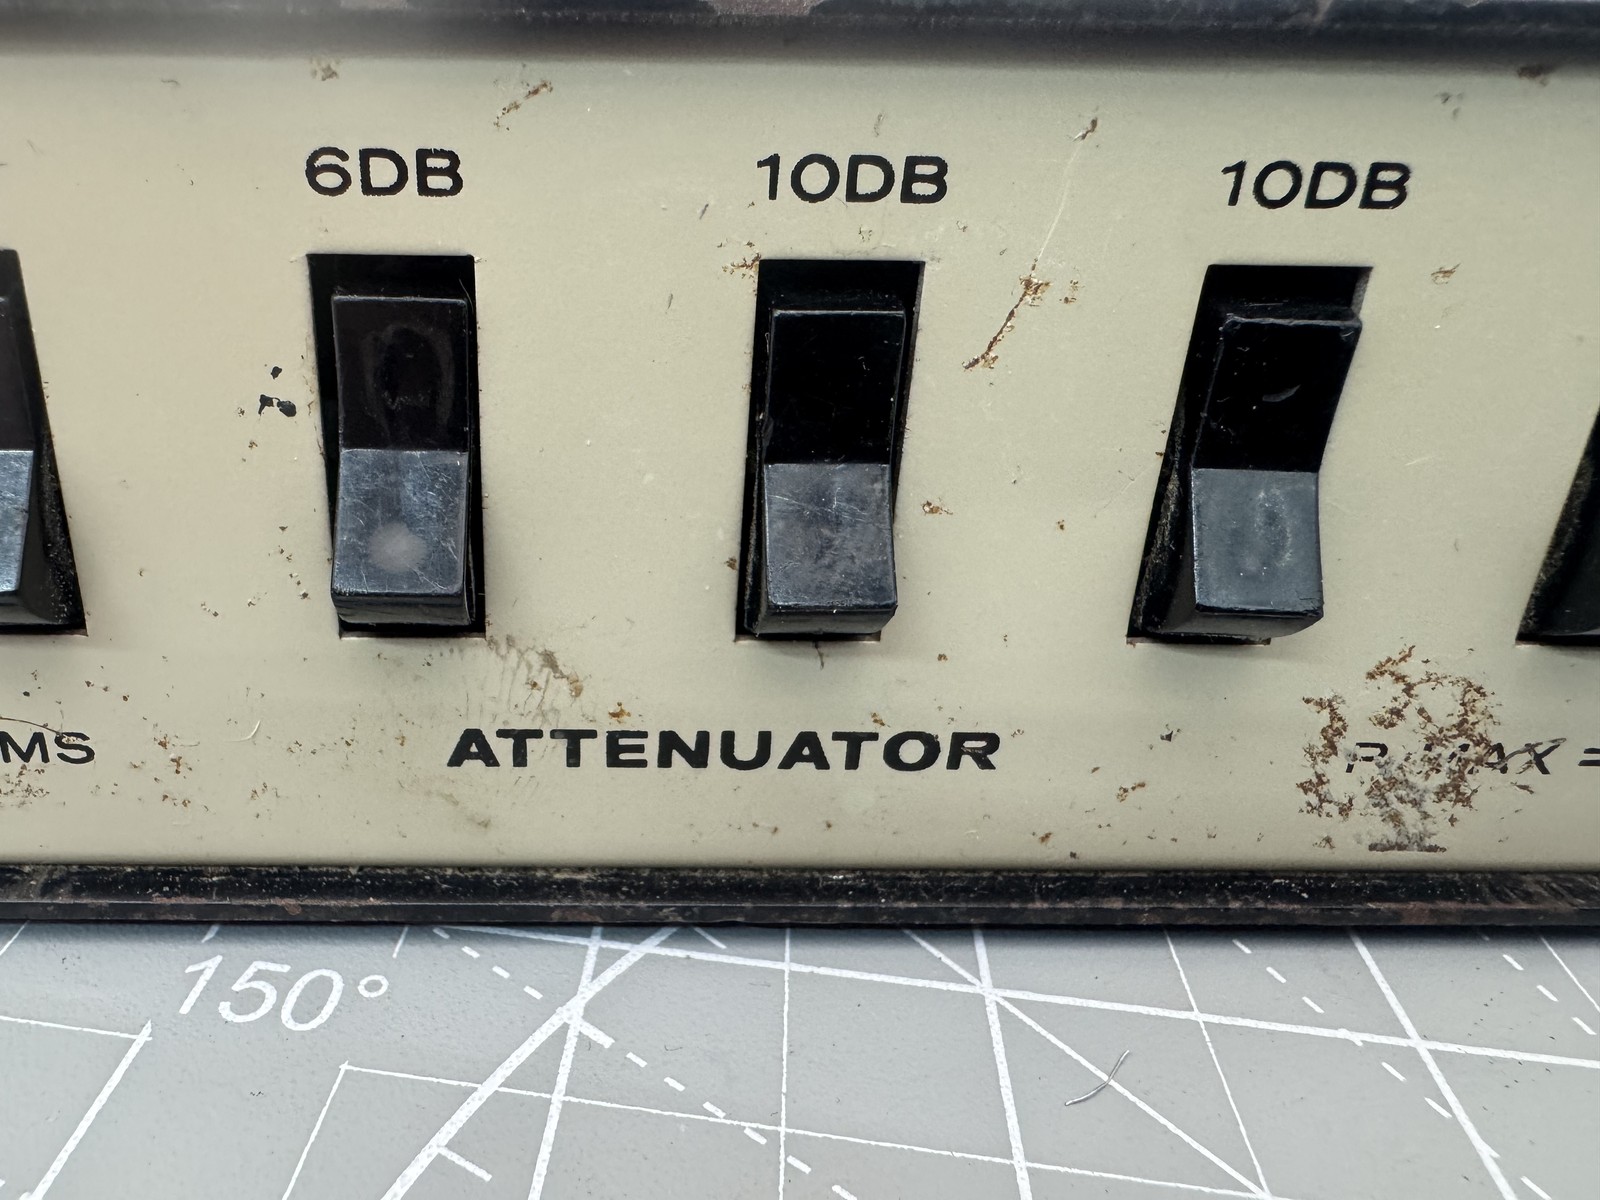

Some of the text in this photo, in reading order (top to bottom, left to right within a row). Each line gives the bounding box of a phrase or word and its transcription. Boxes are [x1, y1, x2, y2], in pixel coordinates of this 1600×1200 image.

[305, 145, 464, 197] 6DB
[756, 153, 949, 204] 10DB
[1221, 159, 1411, 210] 10DB
[0, 731, 96, 764] MS
[446, 728, 1000, 771] ATTENUATOR
[179, 955, 389, 1031] 150°
